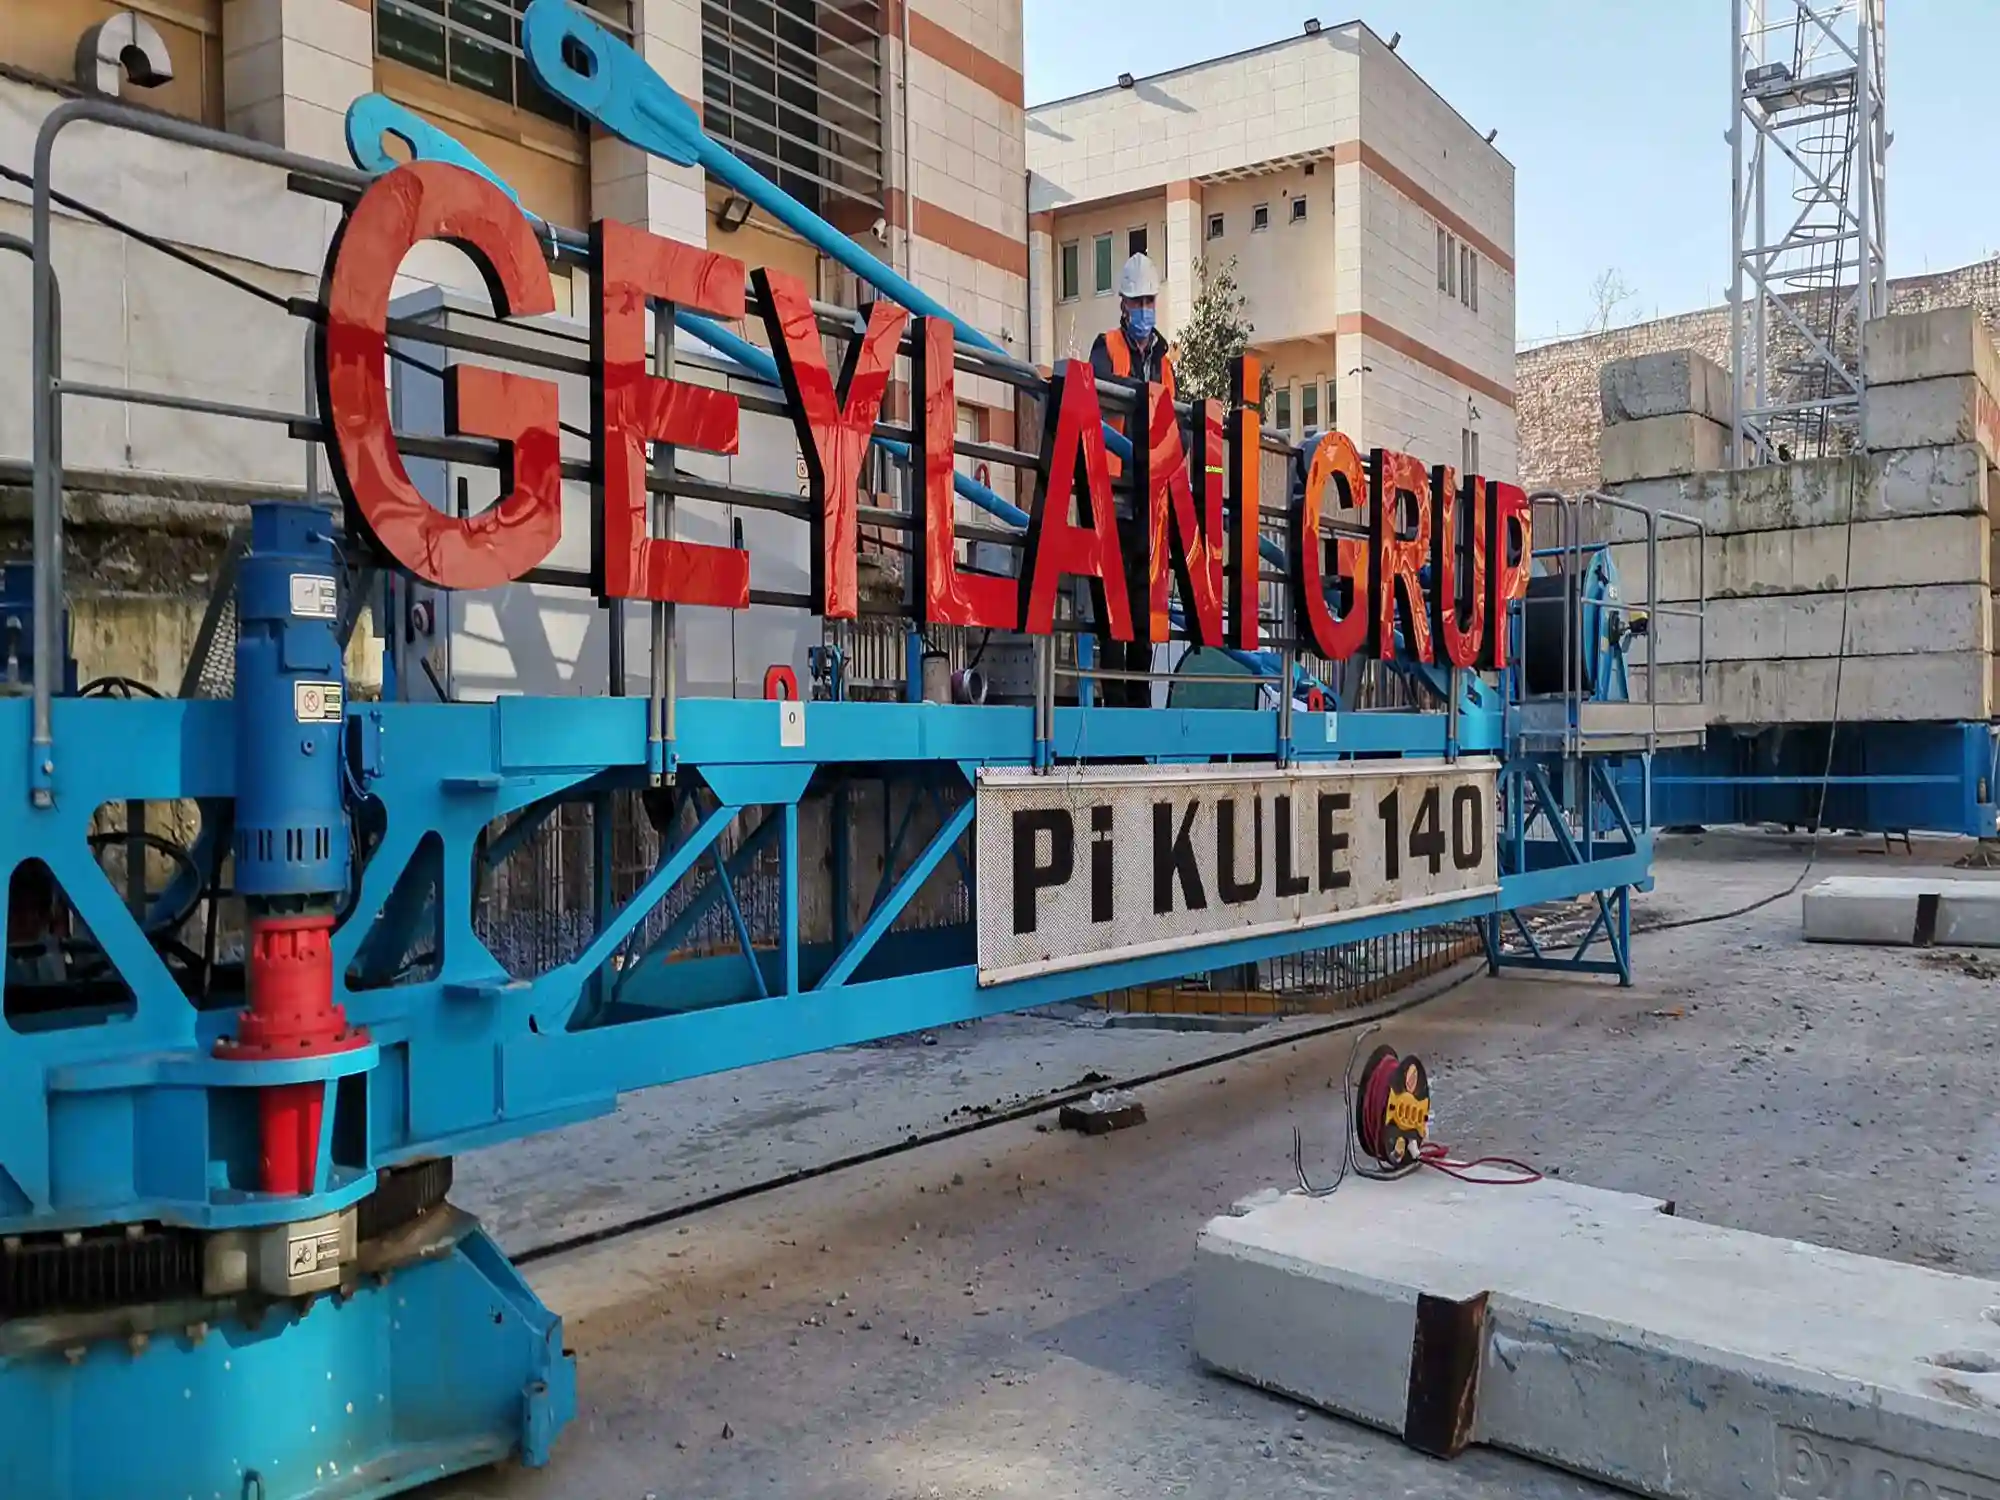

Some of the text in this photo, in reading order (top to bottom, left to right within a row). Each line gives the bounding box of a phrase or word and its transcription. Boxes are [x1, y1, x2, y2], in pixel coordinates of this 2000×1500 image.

[1294, 431, 1532, 669] GRUP
[1153, 792, 1352, 915] KULE
[1378, 784, 1483, 881] 140
